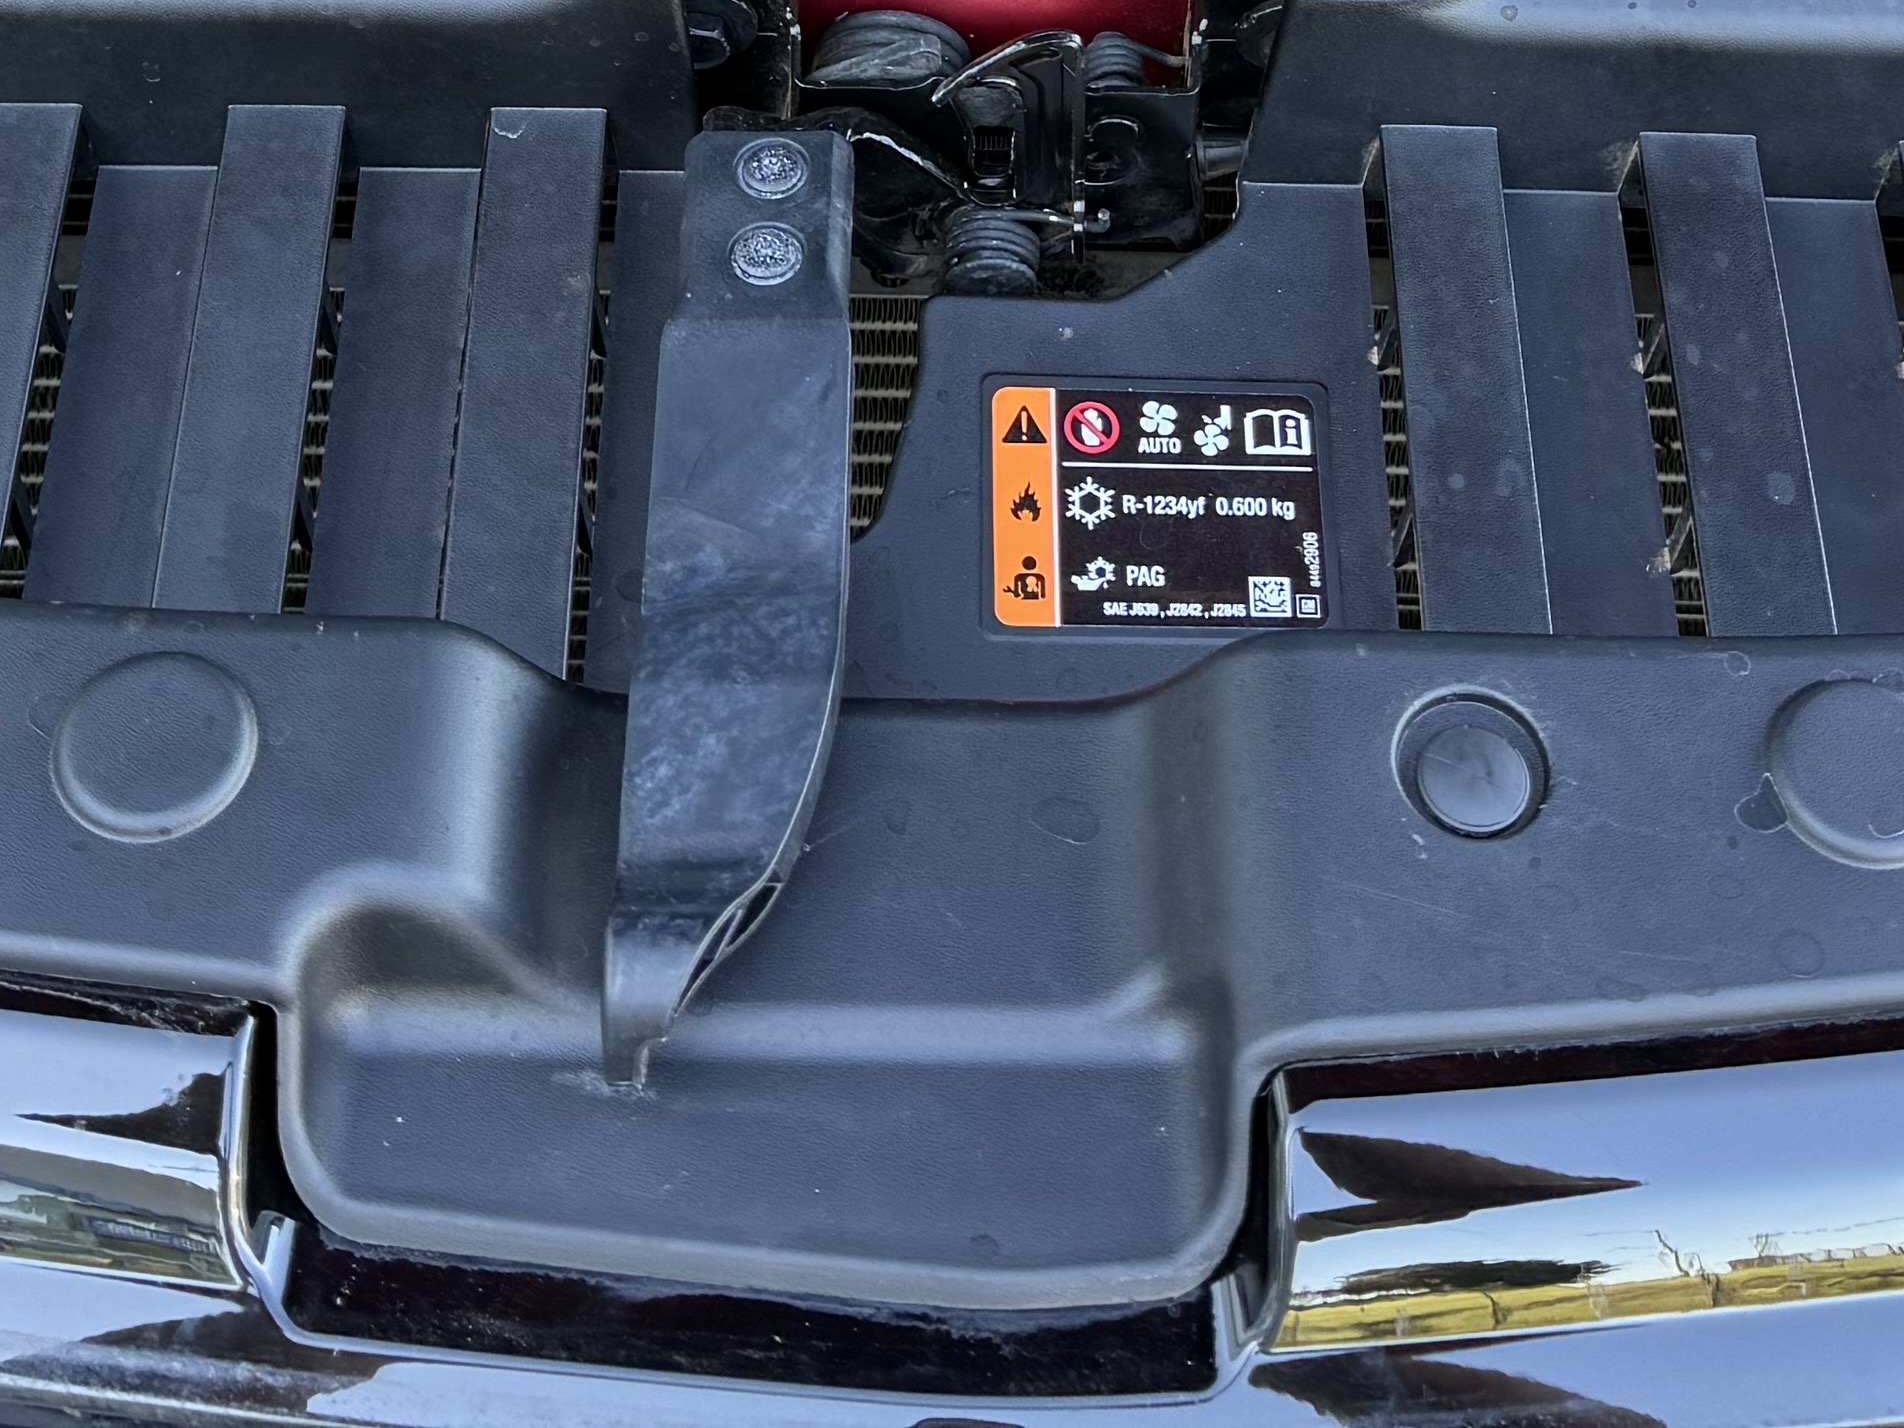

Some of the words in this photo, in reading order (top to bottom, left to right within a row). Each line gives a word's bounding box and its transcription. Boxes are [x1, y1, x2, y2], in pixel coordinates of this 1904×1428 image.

[1138, 437, 1181, 455] AUTO
[1122, 497, 1206, 519] R-1234yf
[1215, 498, 1267, 517] 0.600
[1271, 498, 1295, 520] kg
[1126, 565, 1165, 587] PAG
[1103, 602, 1128, 617] SAE
